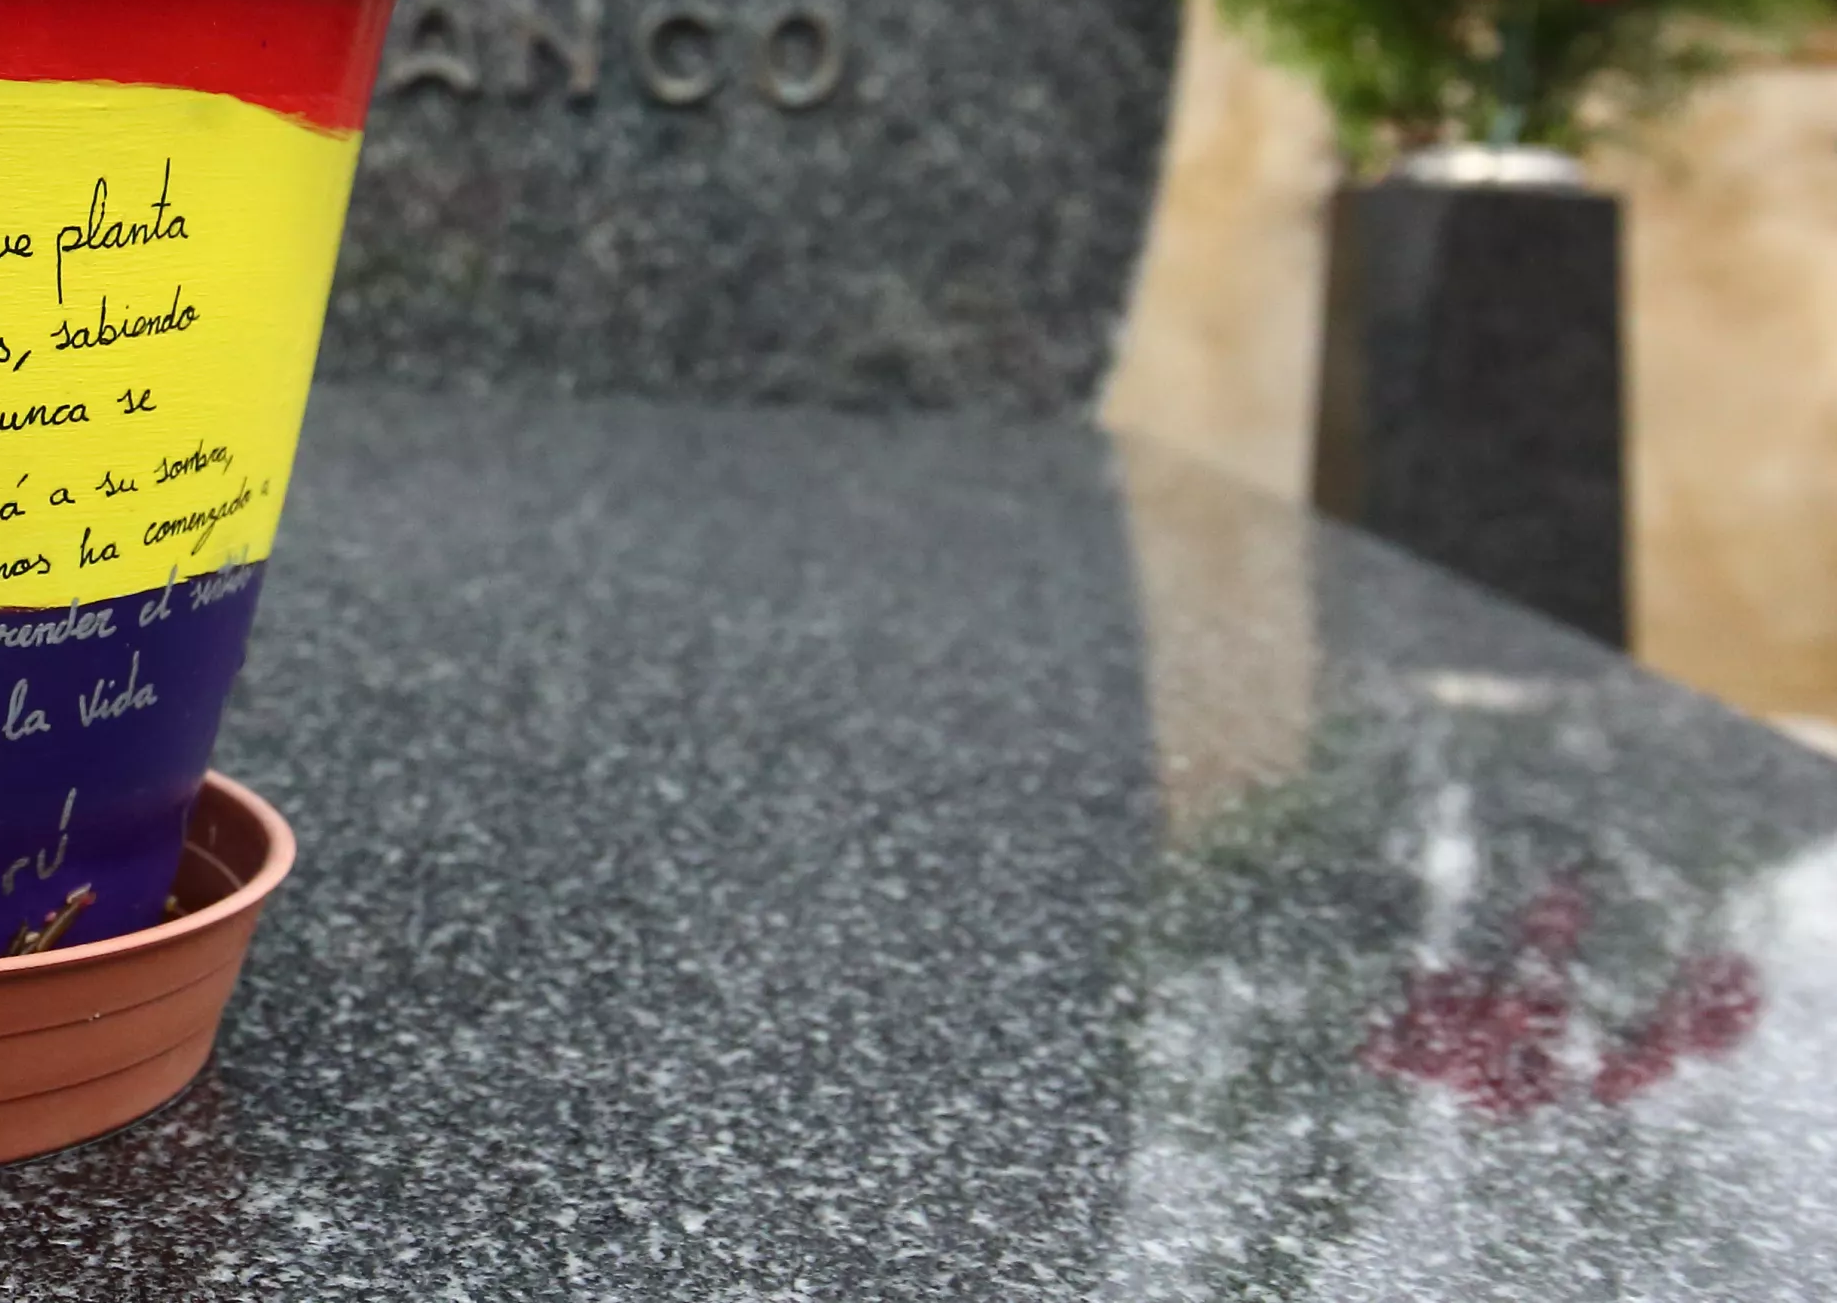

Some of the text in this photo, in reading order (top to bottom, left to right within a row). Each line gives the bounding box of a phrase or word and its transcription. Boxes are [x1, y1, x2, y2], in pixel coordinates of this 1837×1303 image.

[56, 157, 190, 306] planta
[50, 284, 200, 352] sabiendo
[116, 387, 157, 417] se
[49, 485, 76, 507] a
[95, 470, 139, 498] su
[78, 526, 120, 571] ha
[143, 475, 252, 557] comenzado
[138, 563, 178, 628] el
[0, 678, 51, 740] la
